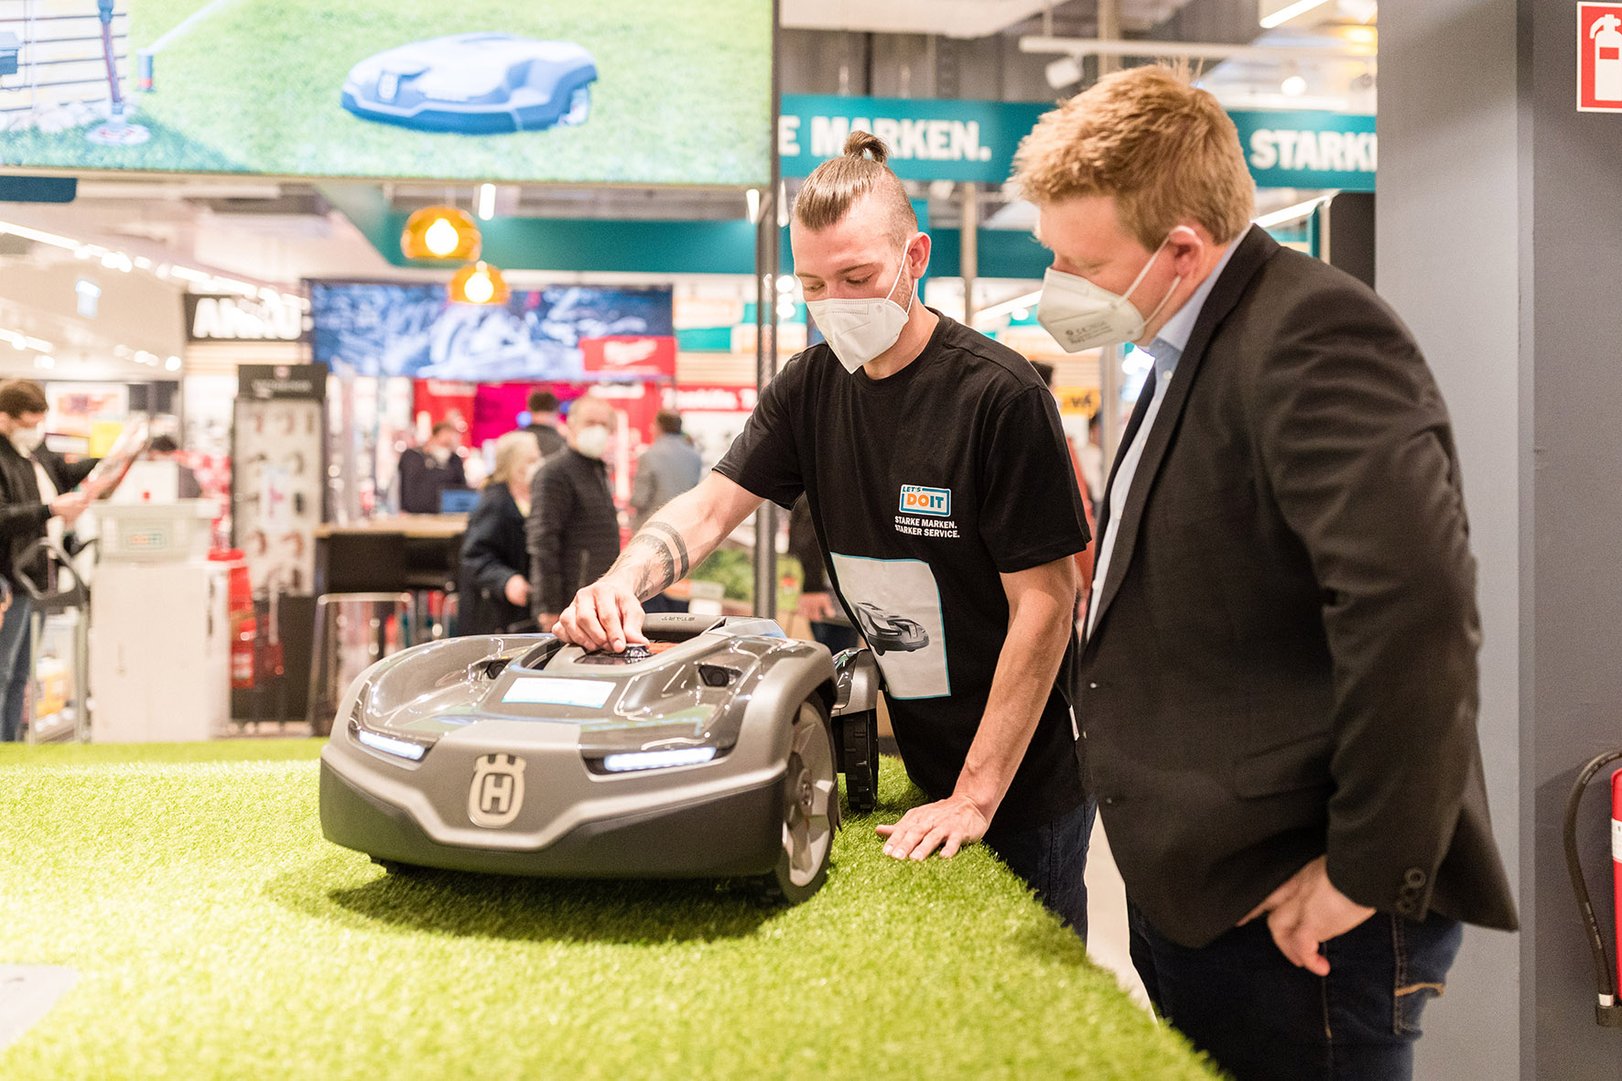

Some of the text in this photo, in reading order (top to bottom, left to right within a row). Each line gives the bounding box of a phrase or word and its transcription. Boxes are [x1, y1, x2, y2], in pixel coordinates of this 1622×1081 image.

[894, 516, 958, 529] STARKE MARKEN.
[894, 524, 960, 538] STARKER SERVICE.
